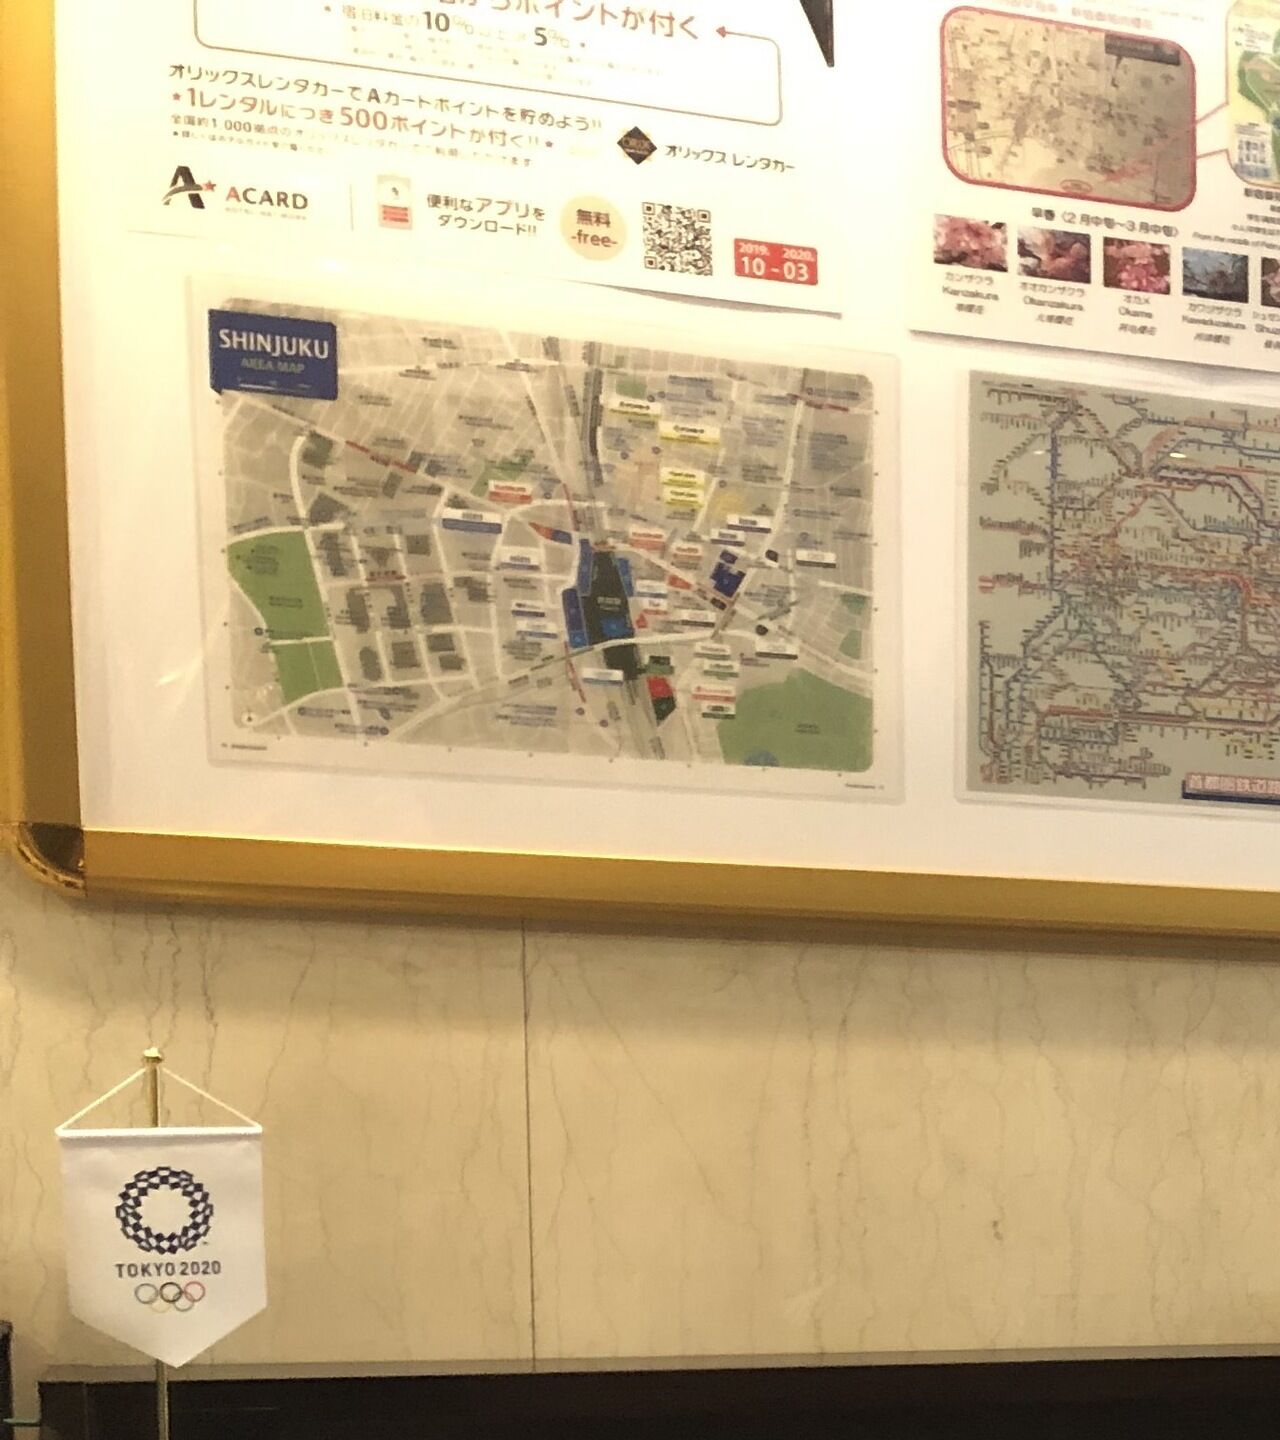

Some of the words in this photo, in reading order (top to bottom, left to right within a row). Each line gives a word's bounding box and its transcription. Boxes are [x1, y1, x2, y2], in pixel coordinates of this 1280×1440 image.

[226, 186, 309, 210] ACARD
[427, 194, 546, 220] 便利なアプリを
[576, 209, 611, 228] 無料
[218, 328, 329, 359] SHINJUKU
[115, 1263, 176, 1278] TOKYO
[180, 1260, 222, 1276] 2020
